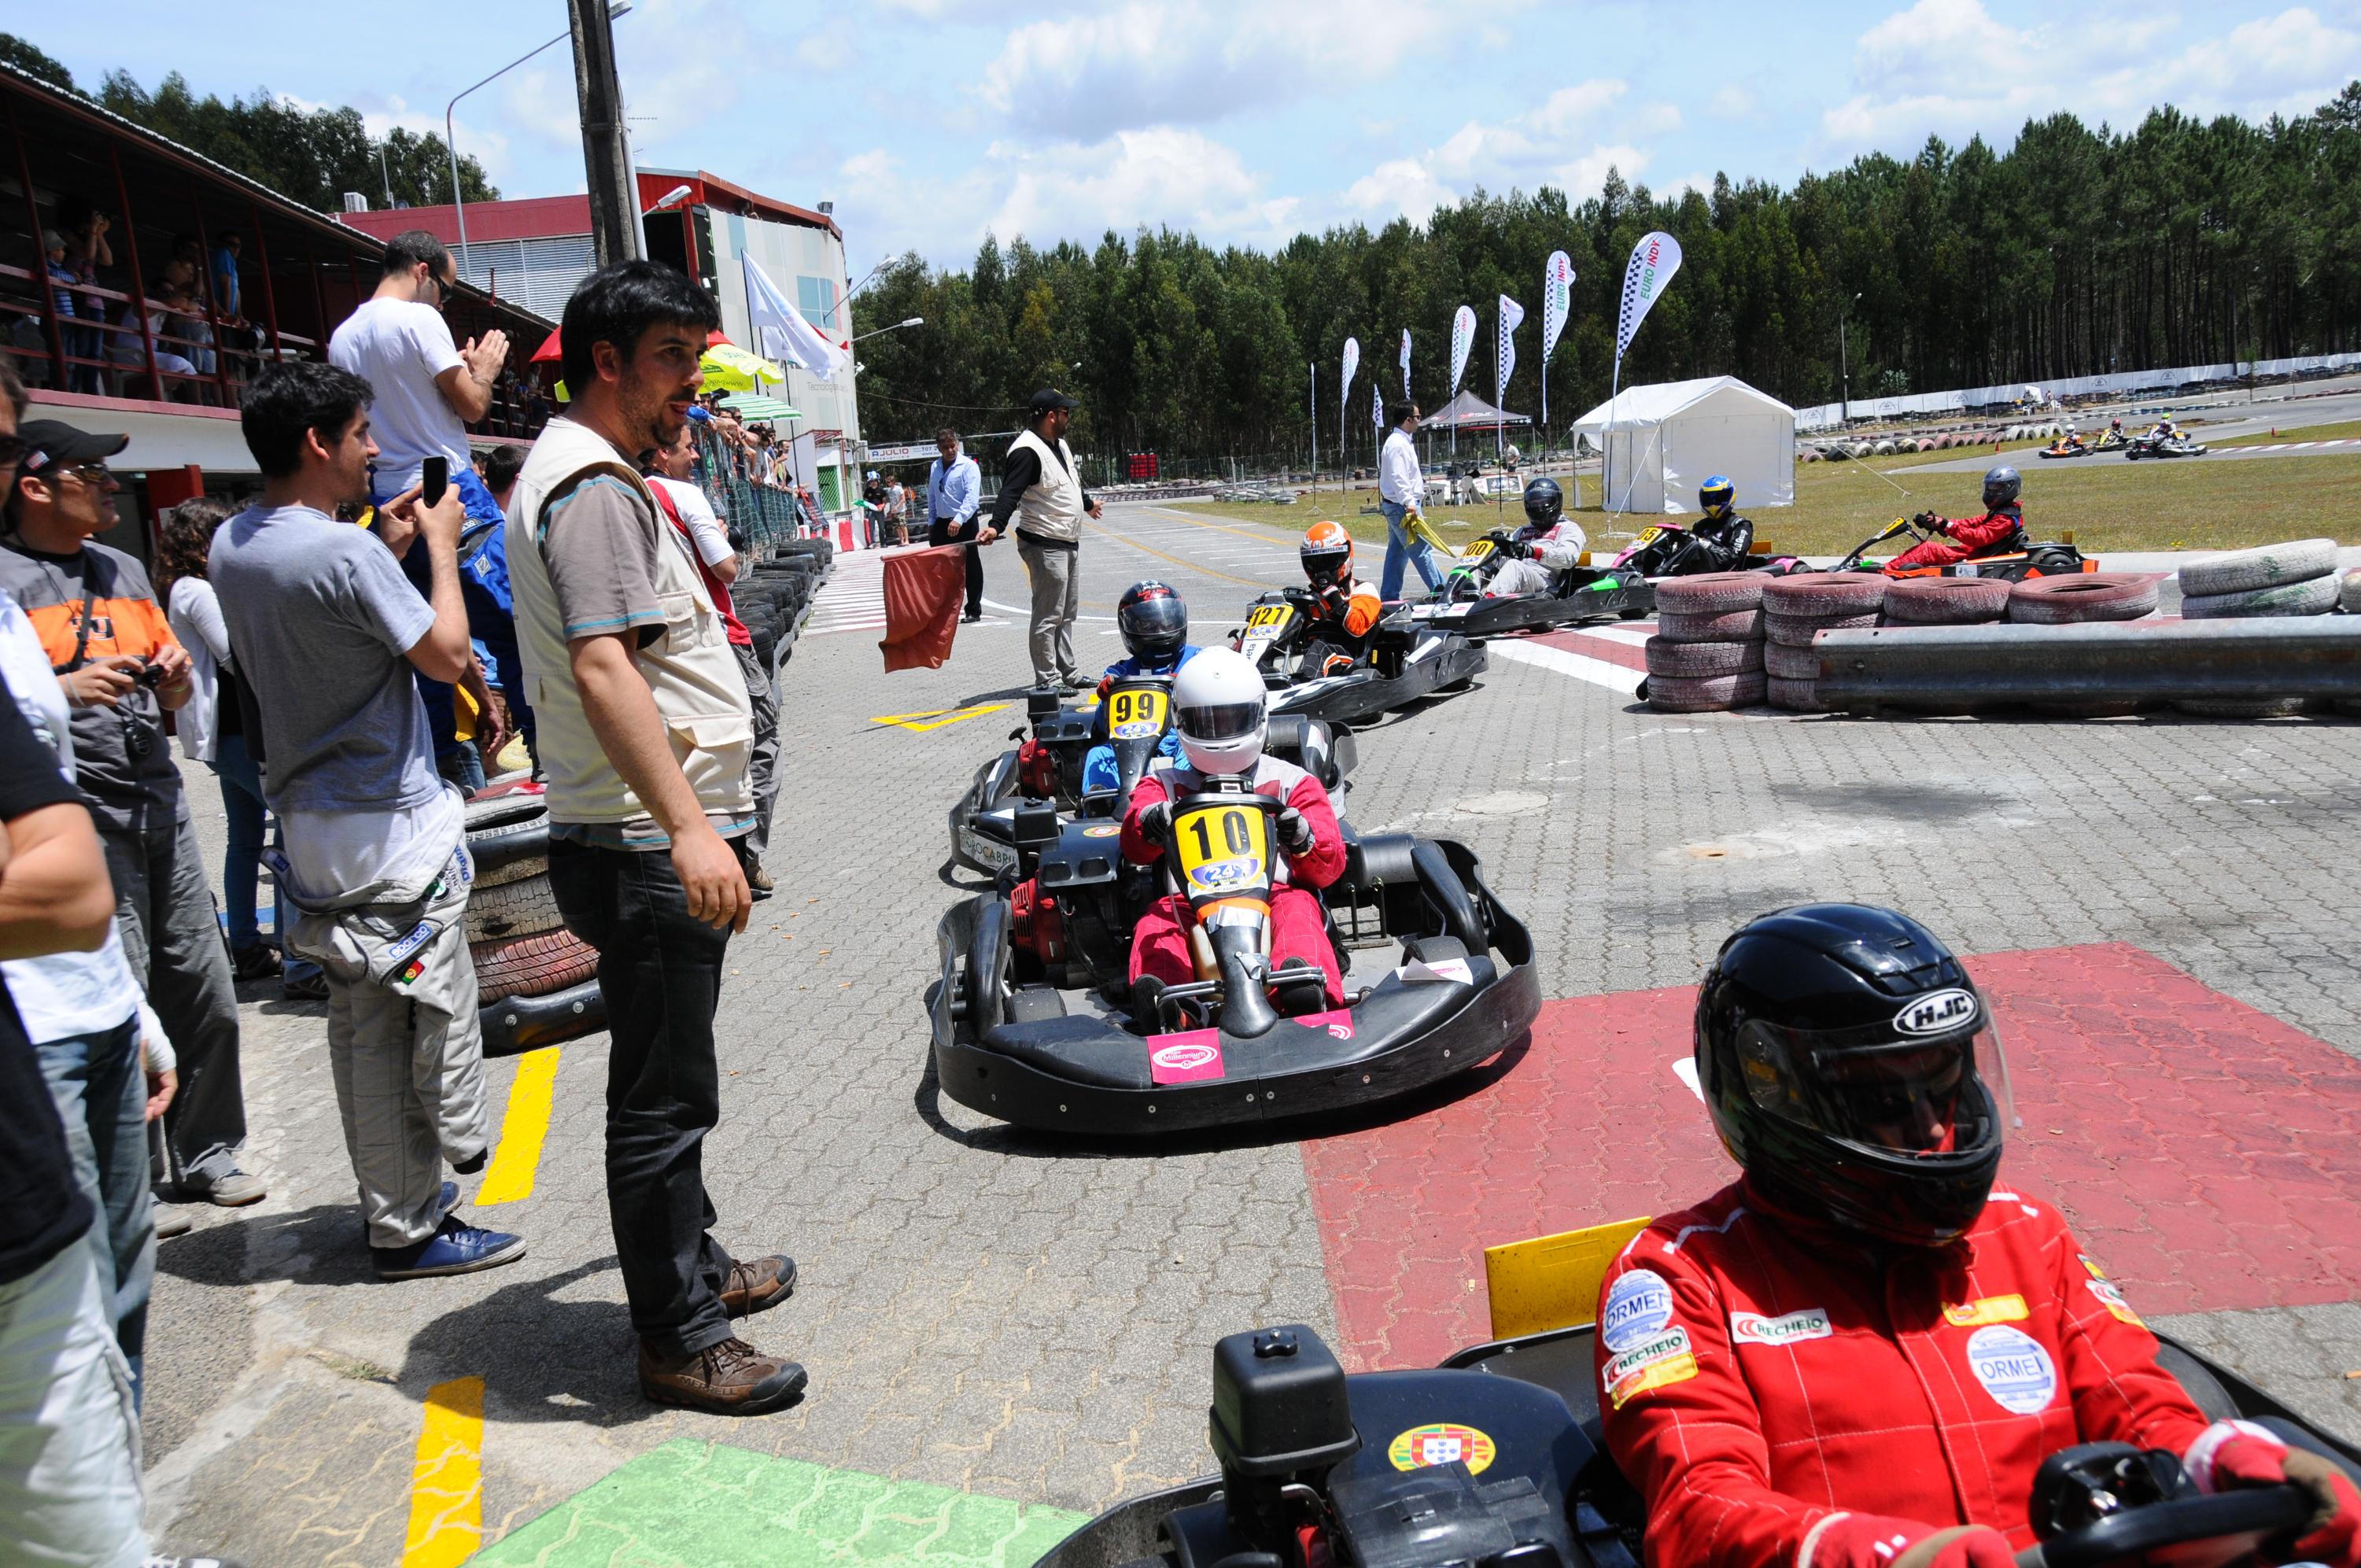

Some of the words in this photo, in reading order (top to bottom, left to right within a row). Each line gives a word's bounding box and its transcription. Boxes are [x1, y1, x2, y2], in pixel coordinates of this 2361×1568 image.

[1647, 240, 1660, 267] INDY
[1640, 268, 1655, 299] EURO
[1557, 284, 1566, 311] EURO
[1636, 528, 1656, 540] 05
[1463, 542, 1489, 555] 100
[1251, 607, 1285, 627] 127
[1116, 692, 1154, 722] 99
[1190, 811, 1251, 861] 10
[1915, 996, 1968, 1028] HJC
[1163, 1052, 1206, 1062] Millennium
[1757, 1317, 1824, 1336] RECHEIO
[1619, 1336, 1683, 1371] RECHEIO
